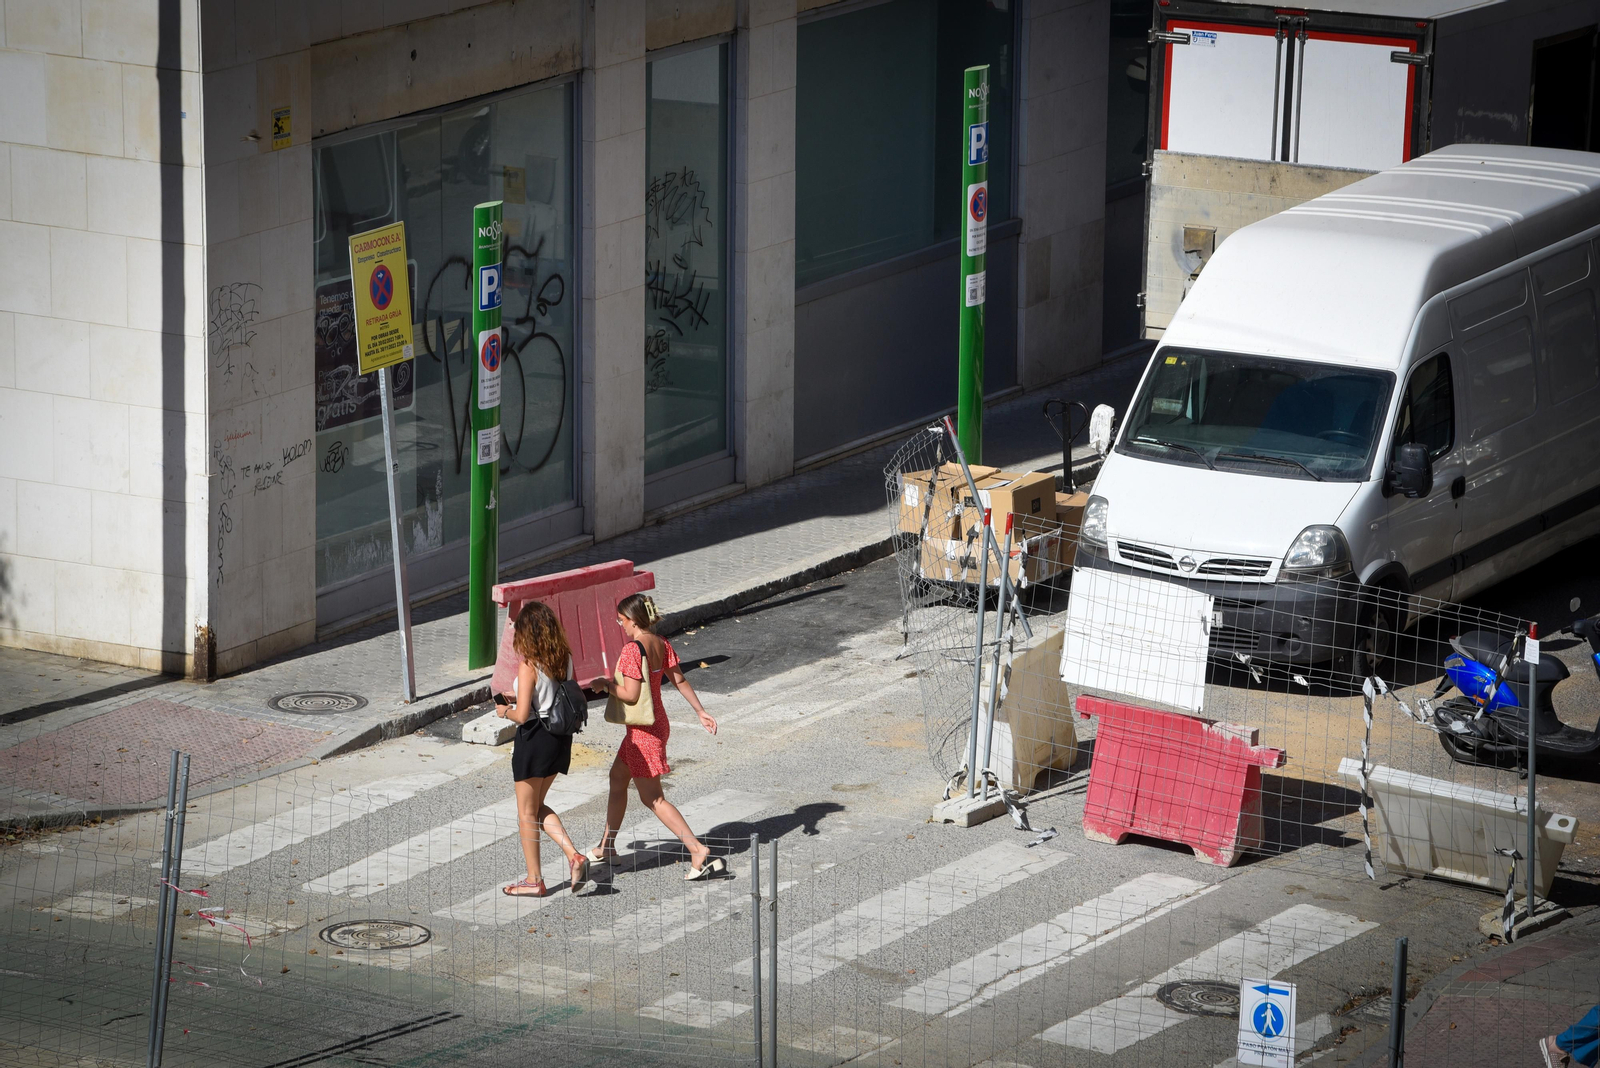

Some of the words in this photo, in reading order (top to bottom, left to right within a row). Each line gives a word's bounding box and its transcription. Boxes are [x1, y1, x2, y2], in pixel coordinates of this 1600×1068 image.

[971, 127, 986, 161] P
[482, 268, 499, 306] P
[320, 291, 349, 305] Tenemos
[320, 303, 343, 317] quedar
[343, 301, 354, 311] má
[366, 314, 389, 326] RETIRADA
[389, 308, 402, 320] GRÚA
[378, 331, 389, 339] OBRAS
[389, 328, 399, 336] DESDE
[318, 397, 357, 424] gratis
